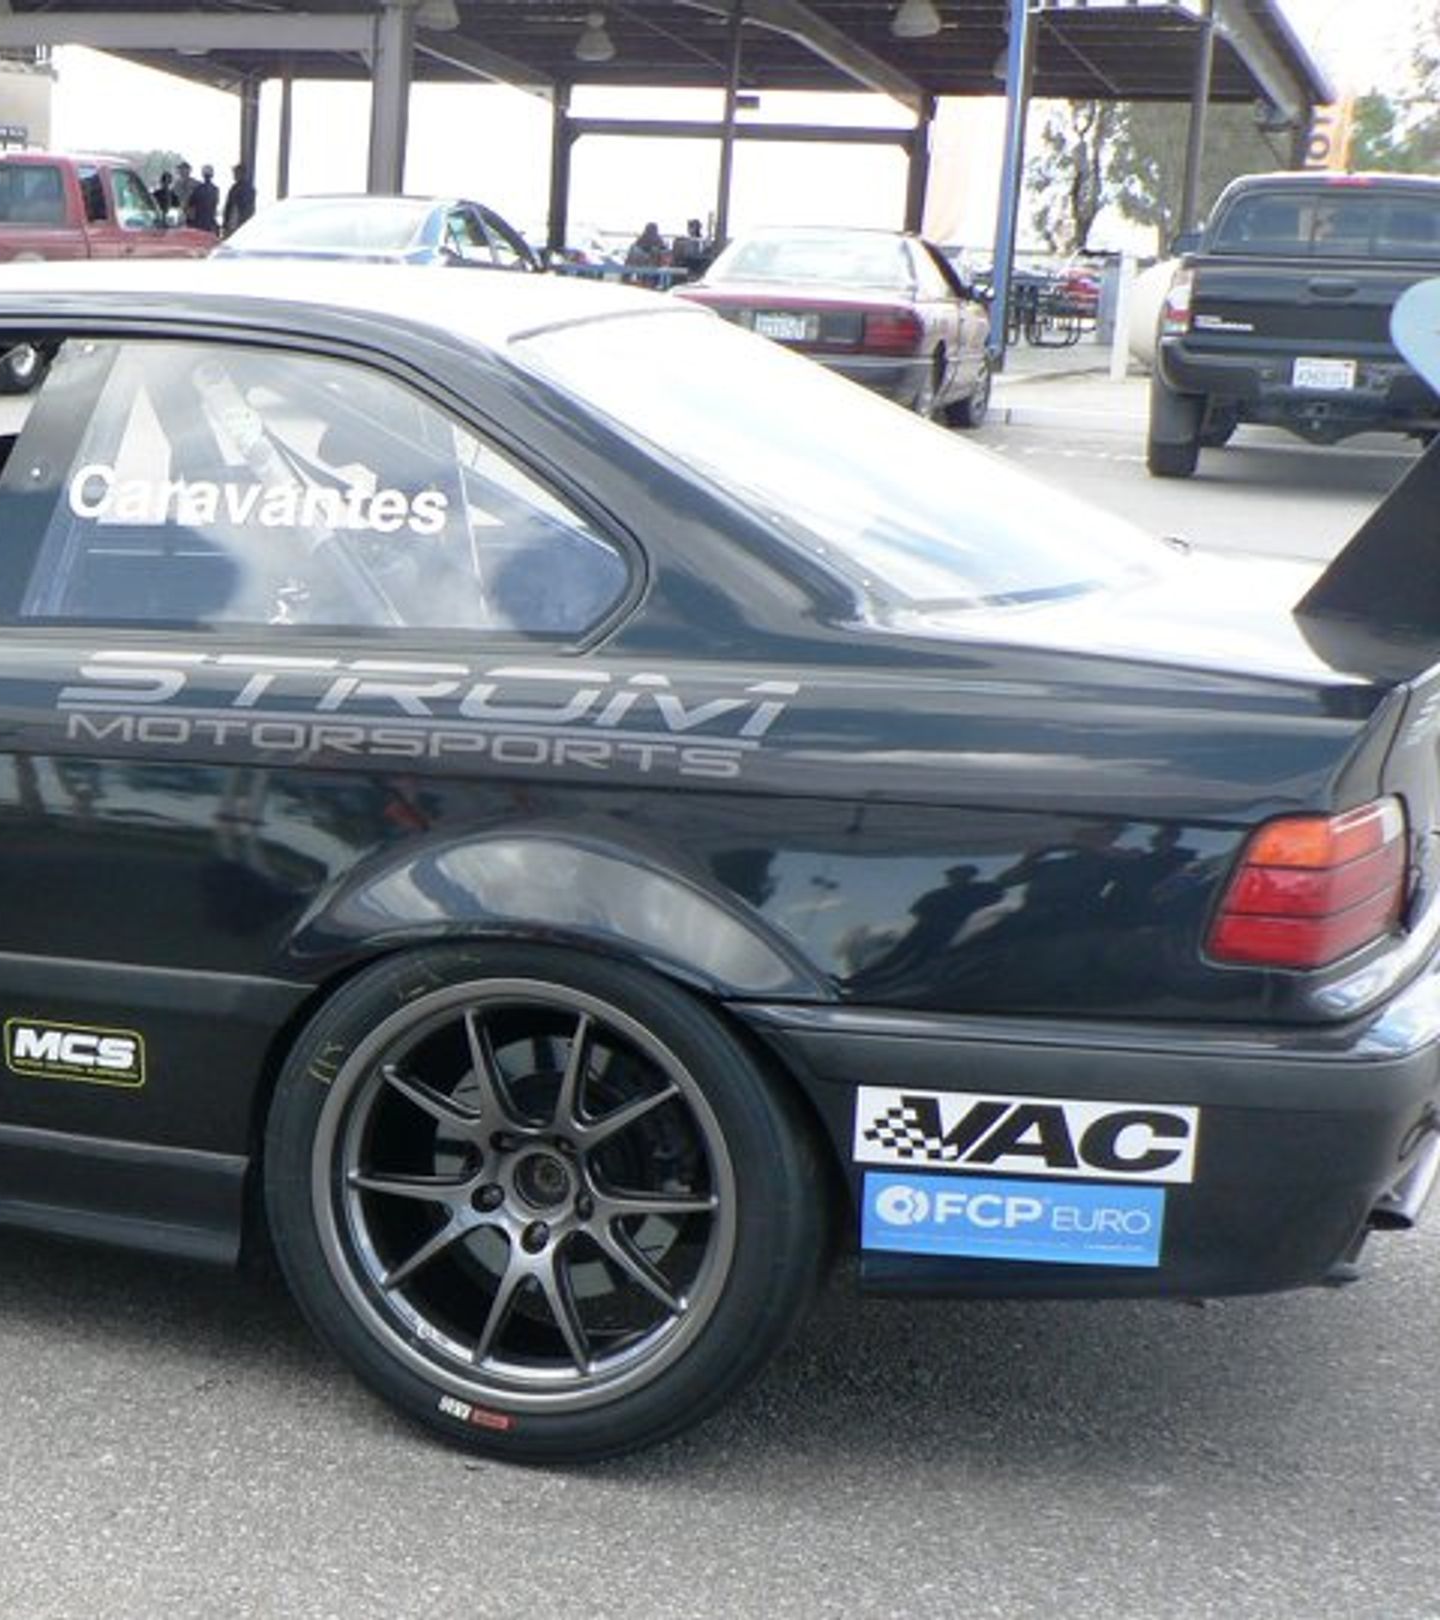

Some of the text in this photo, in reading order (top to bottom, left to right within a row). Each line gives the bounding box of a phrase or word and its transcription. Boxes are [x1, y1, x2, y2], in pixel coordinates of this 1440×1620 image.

[68, 464, 448, 535] Caravantes
[60, 650, 800, 737] STROM
[66, 712, 742, 777] MOTORSPORTS
[14, 1027, 137, 1070] MCS
[898, 1094, 1191, 1173] VAC
[934, 1192, 1153, 1235] FCP EURO
